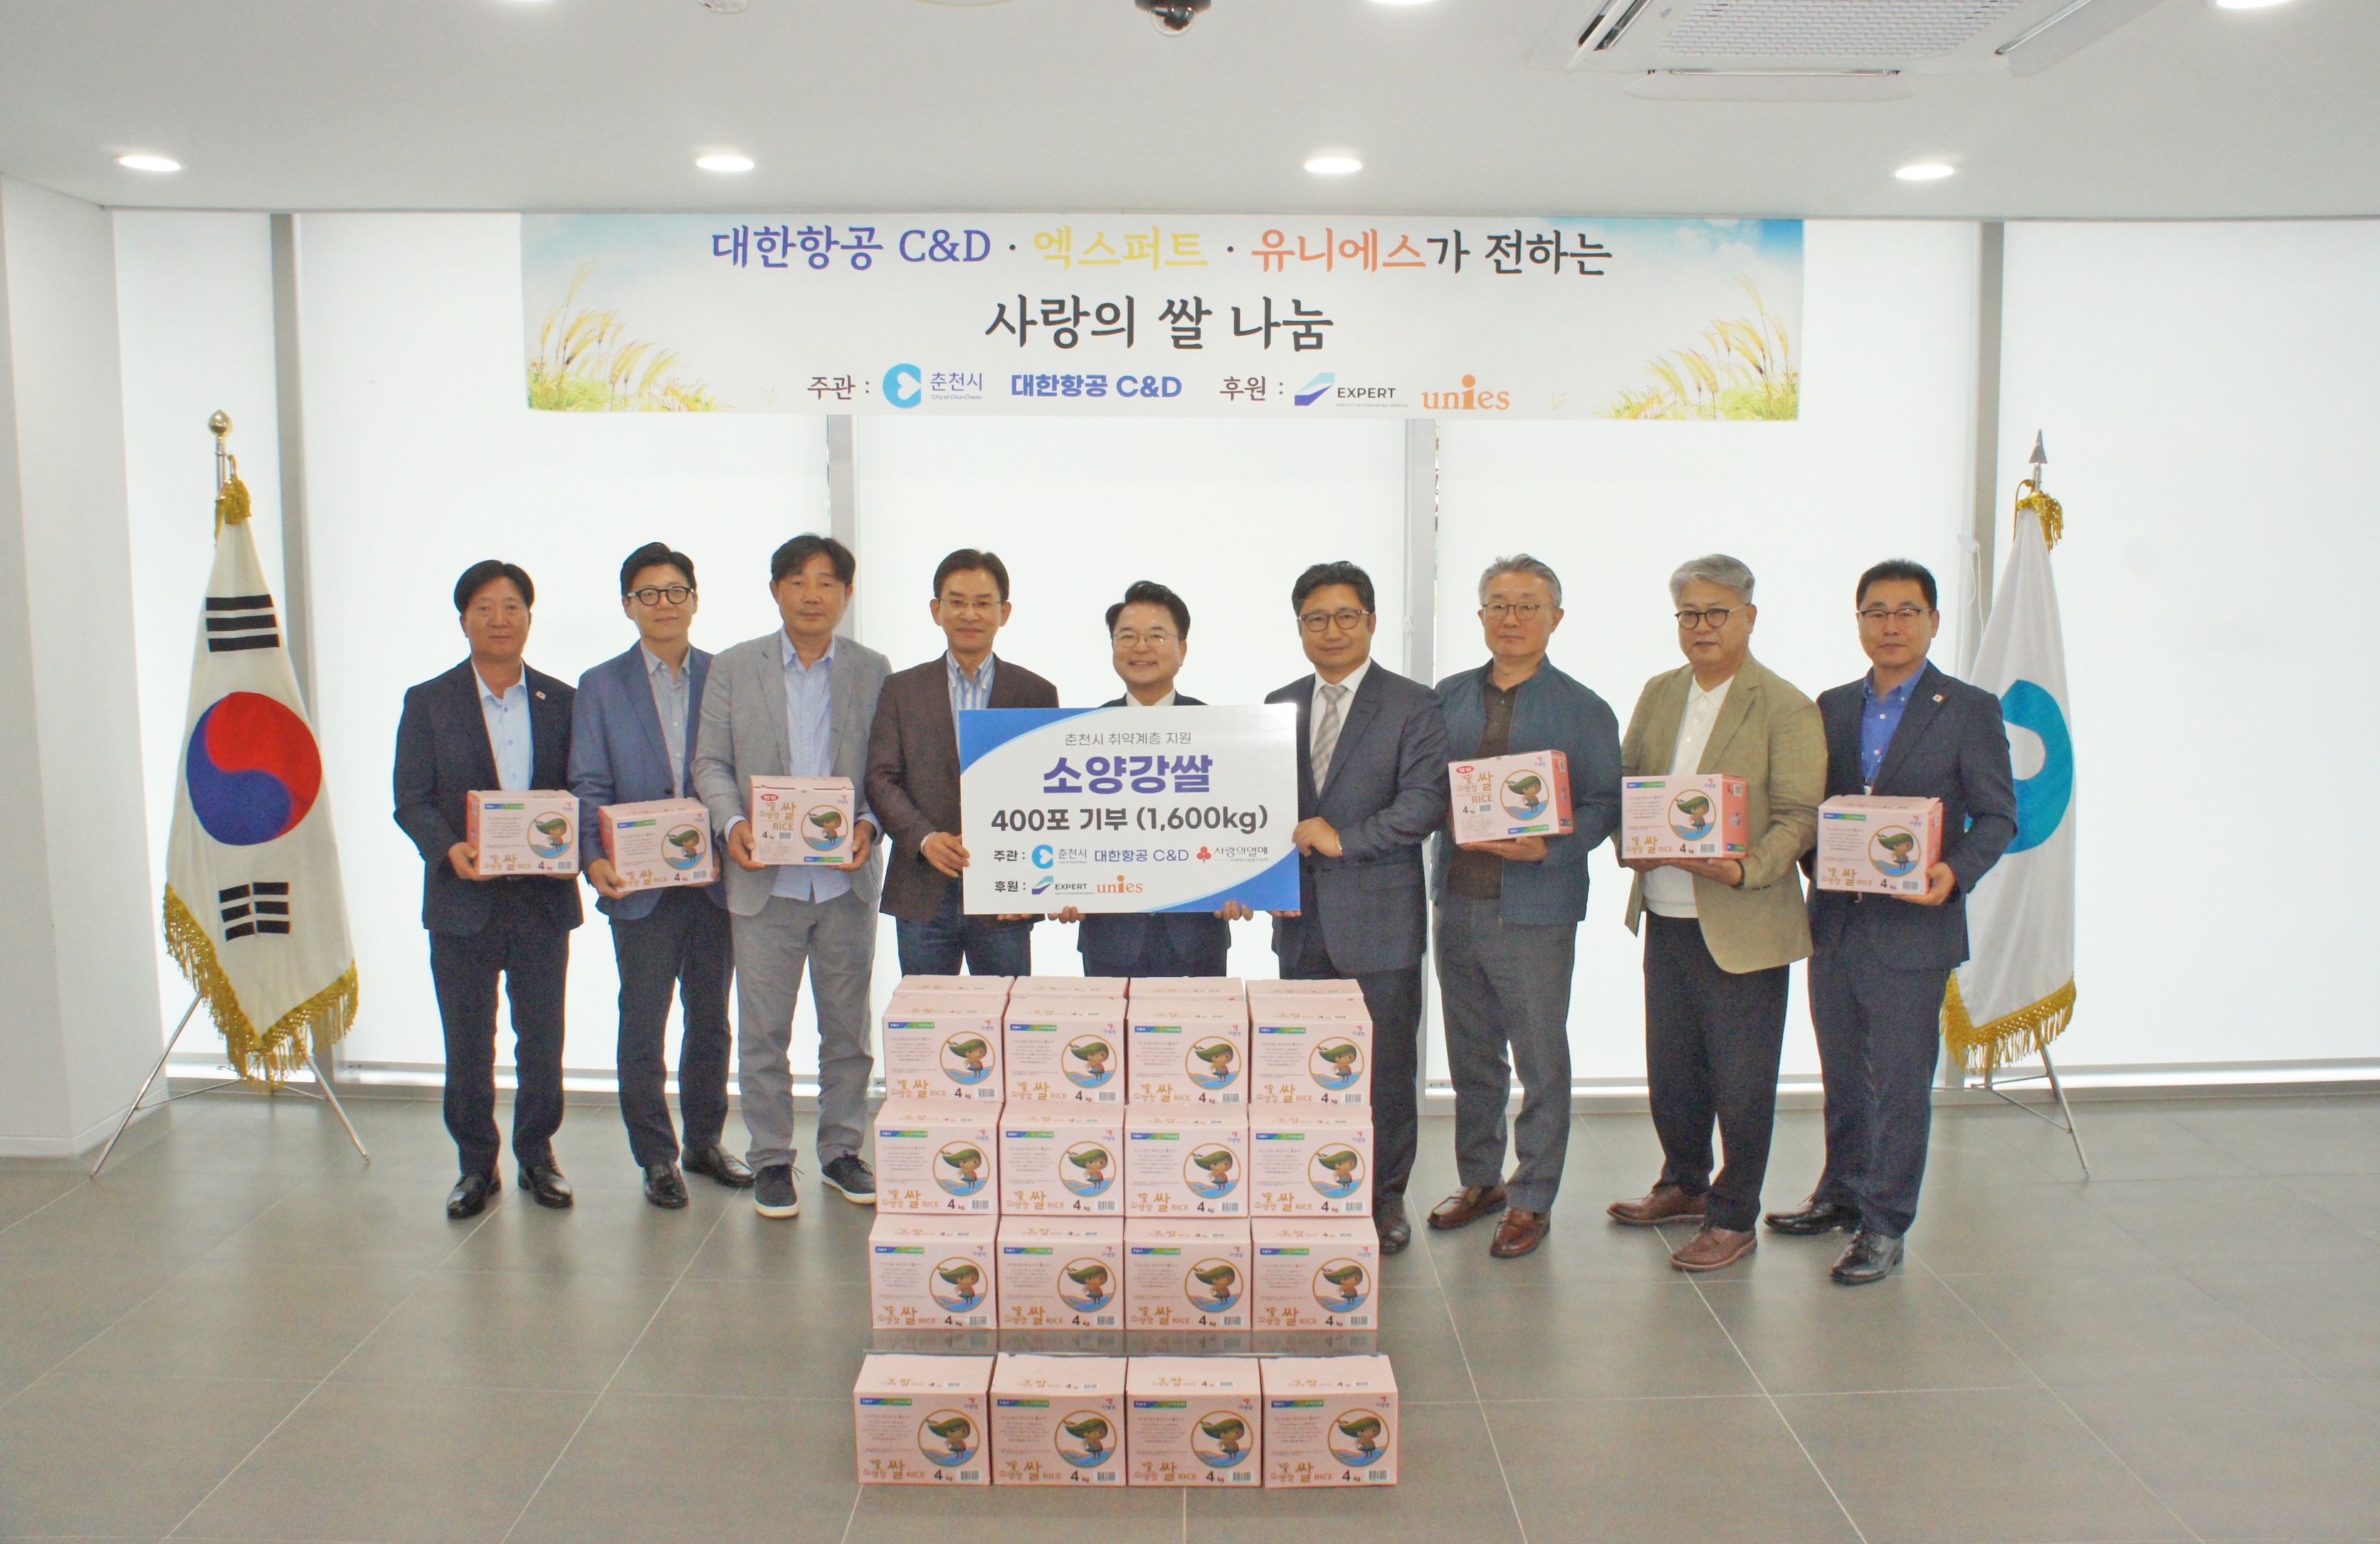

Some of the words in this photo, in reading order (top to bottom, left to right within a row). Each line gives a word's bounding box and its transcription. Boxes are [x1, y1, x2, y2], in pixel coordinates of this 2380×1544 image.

[712, 225, 883, 270] 대한항공
[900, 229, 990, 262] C&D
[1034, 226, 1209, 271] 엑스퍼트
[1252, 228, 1470, 274] 유니에스가
[1485, 229, 1612, 275] 전하는
[985, 294, 1134, 349] 사랑의
[1159, 296, 1213, 349] 쌀
[1231, 296, 1333, 352] 나눔
[808, 375, 855, 400] 주관
[931, 372, 981, 391] 춘천시
[1012, 374, 1107, 397] 대한항공
[1117, 376, 1181, 397] C&D
[1220, 376, 1265, 401] 후원
[1338, 388, 1396, 398] EXPERT
[1422, 375, 1510, 410] unies
[1065, 734, 1103, 746] 춘천시
[1109, 732, 1160, 745] 취약계층
[1167, 732, 1191, 744] 지원
[1043, 755, 1213, 794] 소양강쌀
[1478, 771, 1493, 791] 쌀
[1472, 794, 1493, 803] RICE
[781, 802, 796, 820] 쌀
[991, 809, 1070, 831] 400포
[1080, 808, 1127, 830] 기부
[1137, 805, 1268, 834] (1,600kg)
[1058, 848, 1087, 860] 춘천시
[1214, 846, 1268, 857] 사랑의열매
[1644, 836, 1658, 853] 쌀
[1680, 843, 1686, 853] 4
[503, 854, 517, 870] 쌀
[994, 850, 1018, 862] 주관
[1095, 850, 1148, 862] 대한항공
[1153, 850, 1189, 862] C&D
[640, 869, 653, 885] 쌀
[995, 881, 1018, 892] 후원
[1097, 875, 1143, 893] unies
[1841, 869, 1856, 886] 쌀
[1880, 879, 1887, 888] 4
[891, 1089, 912, 1098] 소양강
[912, 1079, 929, 1098] 쌀
[954, 1088, 962, 1098] 4
[1011, 1091, 1033, 1101] 소양강
[1033, 1082, 1050, 1101] 쌀
[1075, 1091, 1083, 1101] 4
[1134, 1094, 1156, 1103] 소양강
[1157, 1084, 1173, 1103] 쌀
[1199, 1093, 1206, 1103] 4
[1257, 1094, 1278, 1103] 소양강
[1279, 1084, 1295, 1103] 쌀
[1321, 1093, 1329, 1103] 4
[882, 1200, 904, 1209] 소양강
[904, 1190, 921, 1209] 쌀
[947, 1198, 955, 1209] 4
[1007, 1201, 1029, 1210] 소양강
[1030, 1191, 1047, 1210] 쌀
[1073, 1200, 1081, 1210] 4
[1130, 1202, 1152, 1212] 소양강
[1153, 1193, 1170, 1212] 쌀
[1197, 1202, 1205, 1212] 4
[1255, 1202, 1277, 1212] 소양강
[1278, 1193, 1295, 1212] 쌀
[1321, 1201, 1329, 1212] 4
[901, 1306, 918, 1326] 쌀
[944, 1315, 952, 1326] 4
[1028, 1306, 1046, 1326] 쌀
[1073, 1315, 1080, 1326] 4
[1155, 1306, 1172, 1326] 쌀
[1199, 1315, 1206, 1326] 4
[1281, 1306, 1299, 1326] 쌀
[1326, 1316, 1334, 1326] 4
[887, 1459, 905, 1481] 쌀
[934, 1469, 943, 1481] 4
[1023, 1461, 1042, 1482] 쌀
[1070, 1471, 1080, 1482] 4
[1159, 1461, 1177, 1482] 쌀
[1206, 1471, 1215, 1482] 4
[1295, 1460, 1313, 1481] 쌀
[1342, 1470, 1351, 1481] 4
